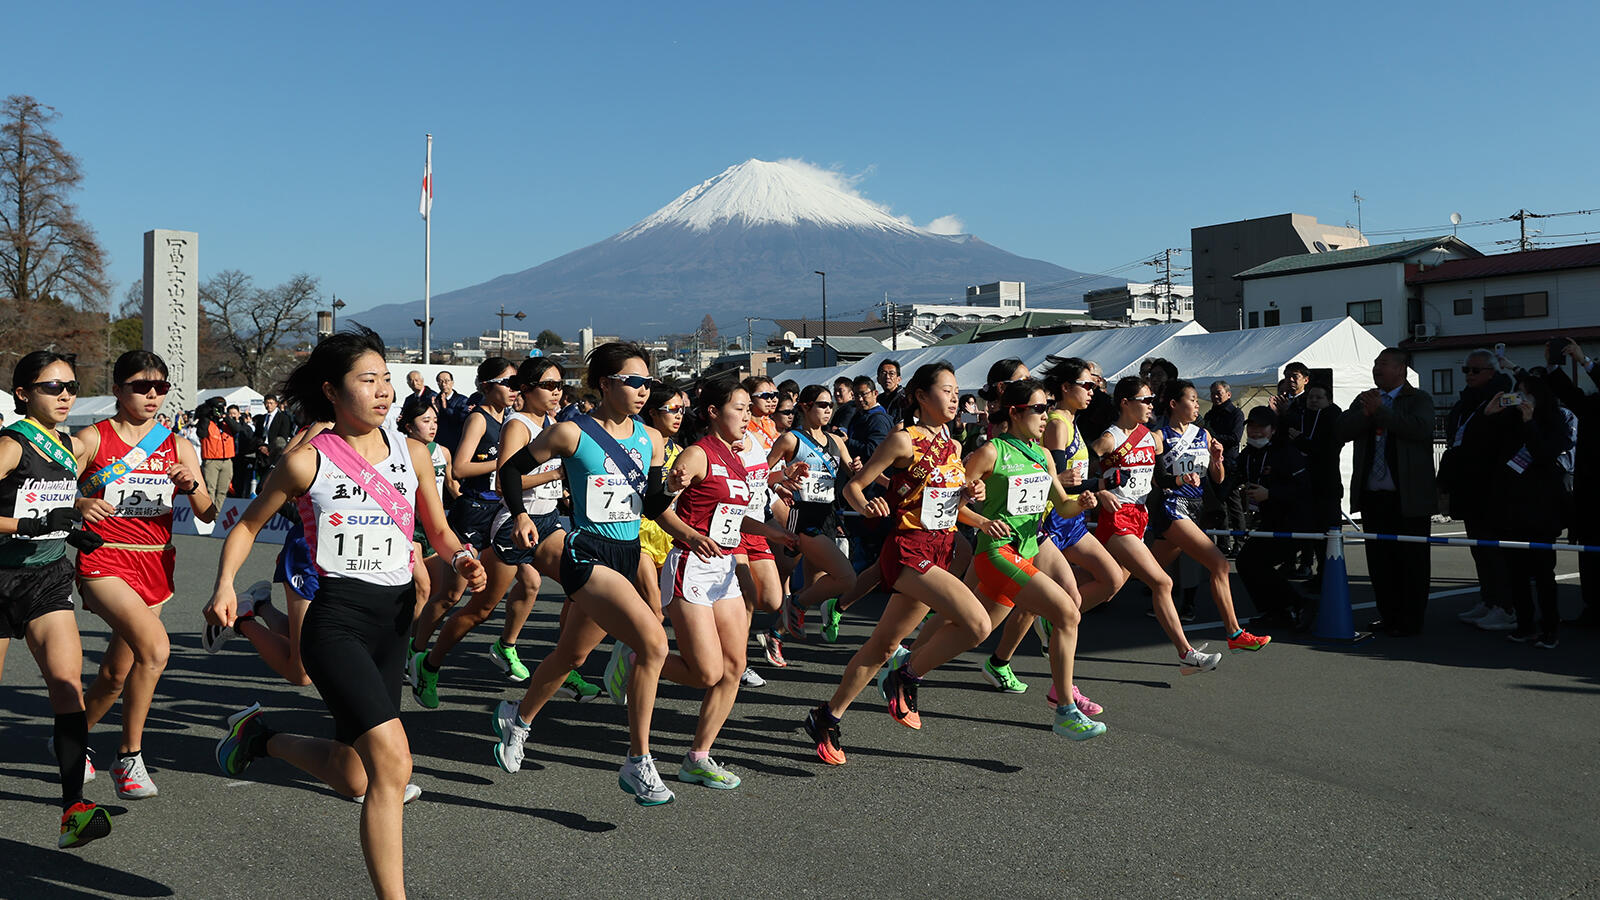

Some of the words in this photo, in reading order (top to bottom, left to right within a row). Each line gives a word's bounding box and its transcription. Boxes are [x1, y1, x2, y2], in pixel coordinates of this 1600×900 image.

[1124, 449, 1154, 465] 福岡大
[39, 493, 74, 503] SUZUKI
[117, 489, 163, 506] 15-1
[1018, 488, 1043, 504] 2-1
[333, 533, 394, 556] 11-1
[345, 559, 392, 571] 玉川大
